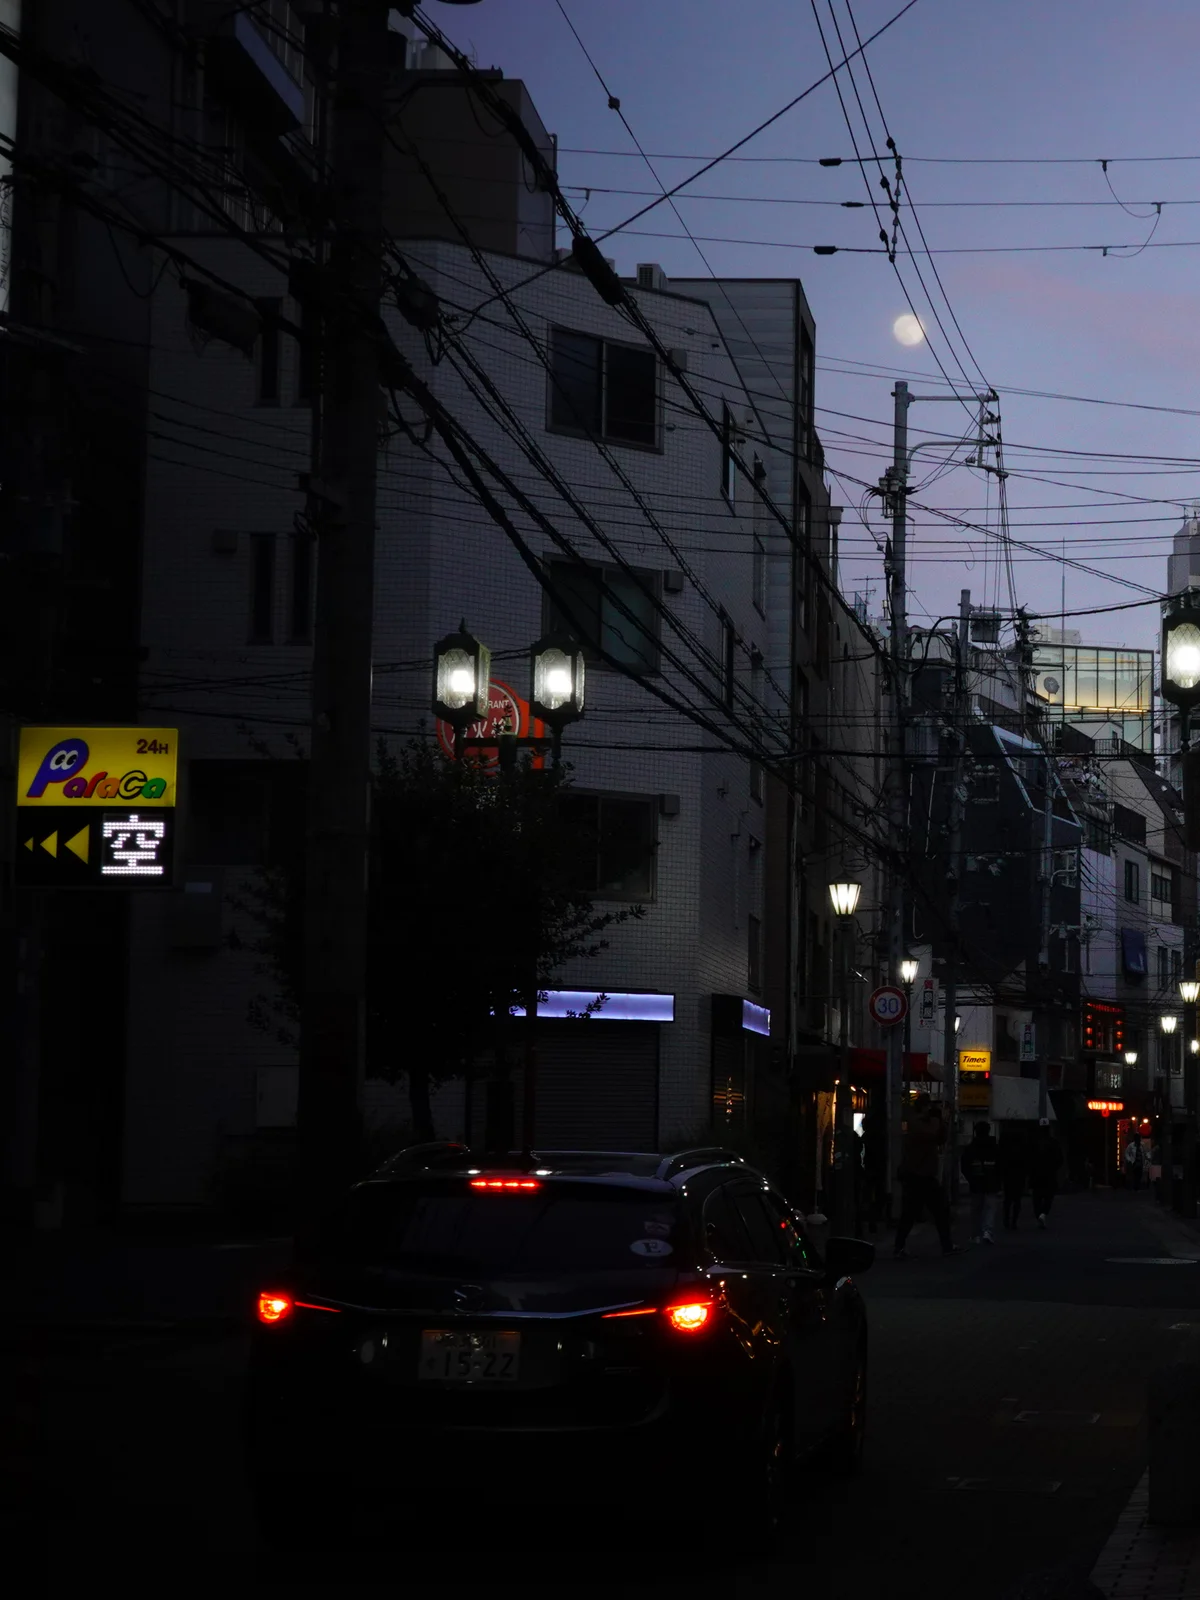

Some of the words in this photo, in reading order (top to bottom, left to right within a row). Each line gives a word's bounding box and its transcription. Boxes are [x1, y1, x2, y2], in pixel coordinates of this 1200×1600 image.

[136, 738, 169, 755] 24H
[101, 814, 164, 875] 空
[877, 997, 899, 1014] 30
[962, 1055, 987, 1063] Times
[642, 1242, 661, 1253] E
